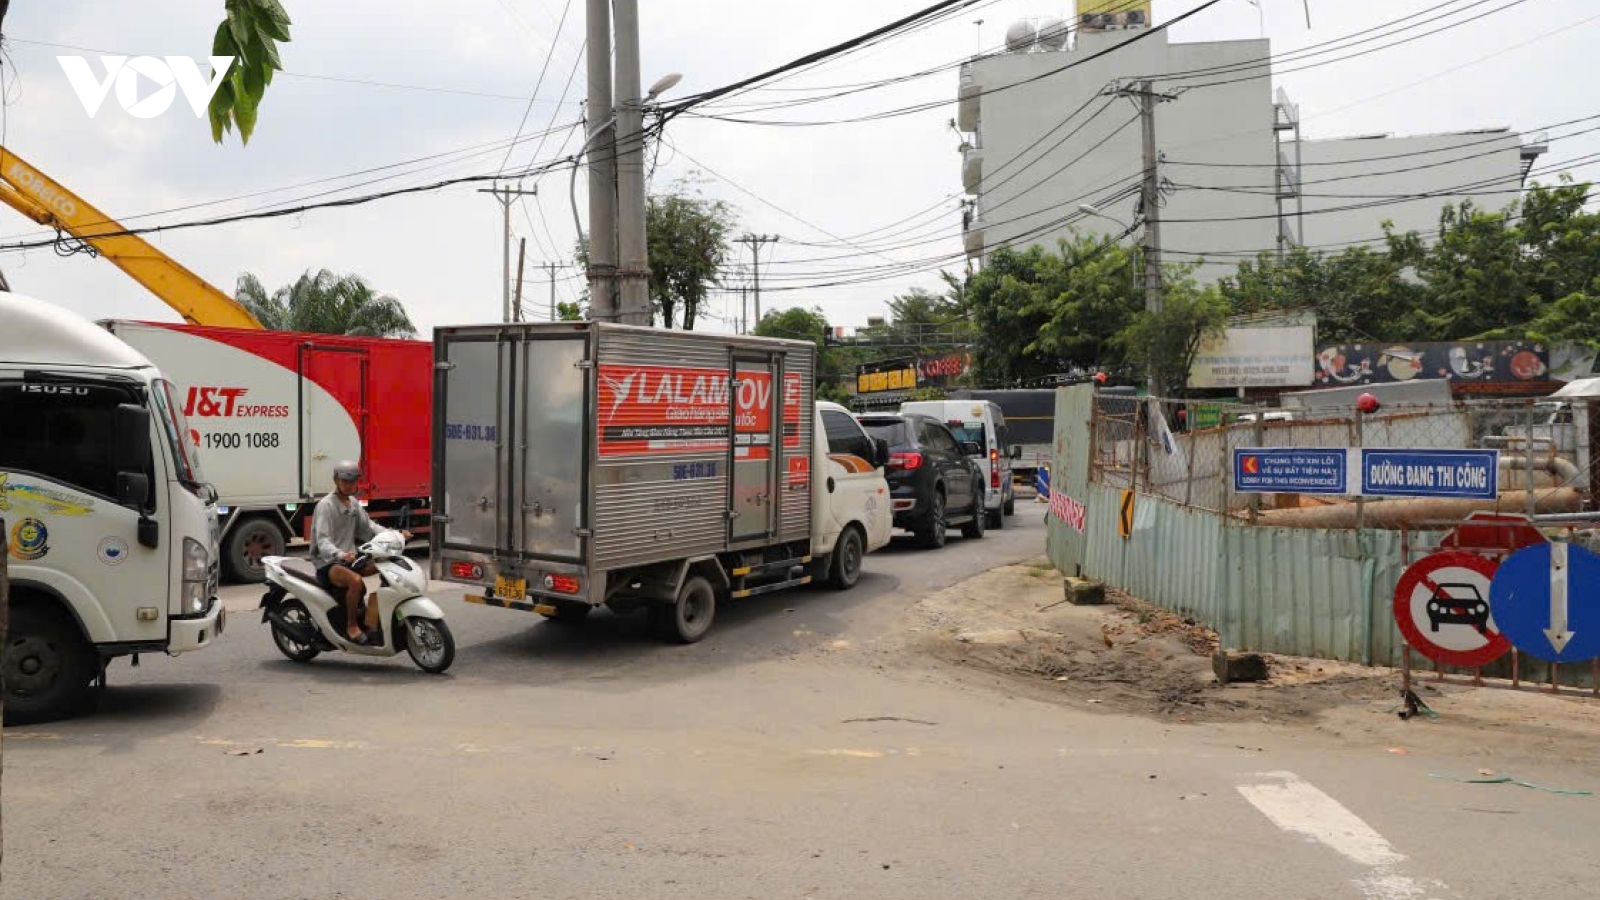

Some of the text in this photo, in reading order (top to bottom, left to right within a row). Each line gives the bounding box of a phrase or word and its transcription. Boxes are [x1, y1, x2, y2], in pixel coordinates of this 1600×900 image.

[9, 162, 77, 217] KOBELCO
[21, 383, 89, 395] ISUZU
[183, 386, 289, 417] J&T EXPRESS
[635, 372, 799, 410] LALAMOVE
[204, 432, 279, 449] 1900 1088
[1261, 476, 1273, 484] FOR
[1370, 459, 1487, 488] ĐƯỜNG ĐANG THI CÔNG
